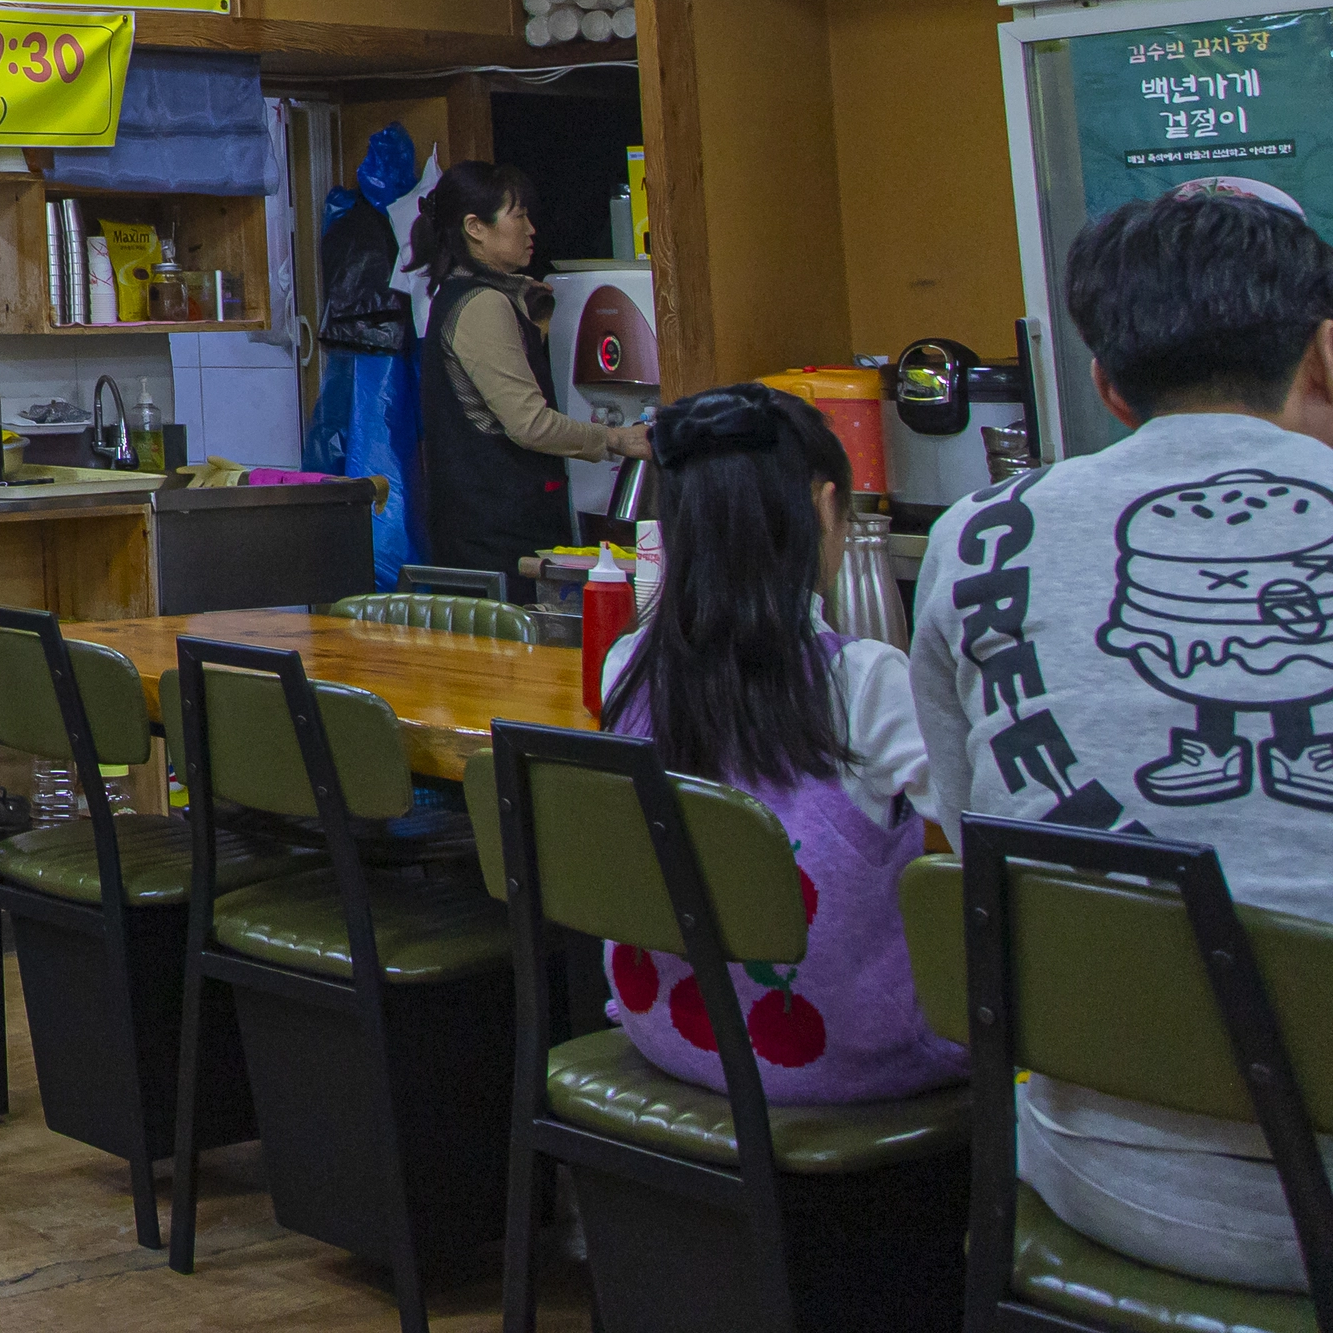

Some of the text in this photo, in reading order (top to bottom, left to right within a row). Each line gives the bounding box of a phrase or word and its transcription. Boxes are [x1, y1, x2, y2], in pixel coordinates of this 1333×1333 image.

[1128, 31, 1270, 64] 김수빈 김치공장
[1142, 68, 1261, 104] 백년가게
[1159, 106, 1247, 139] 겉절이
[113, 229, 150, 244] Maxim
